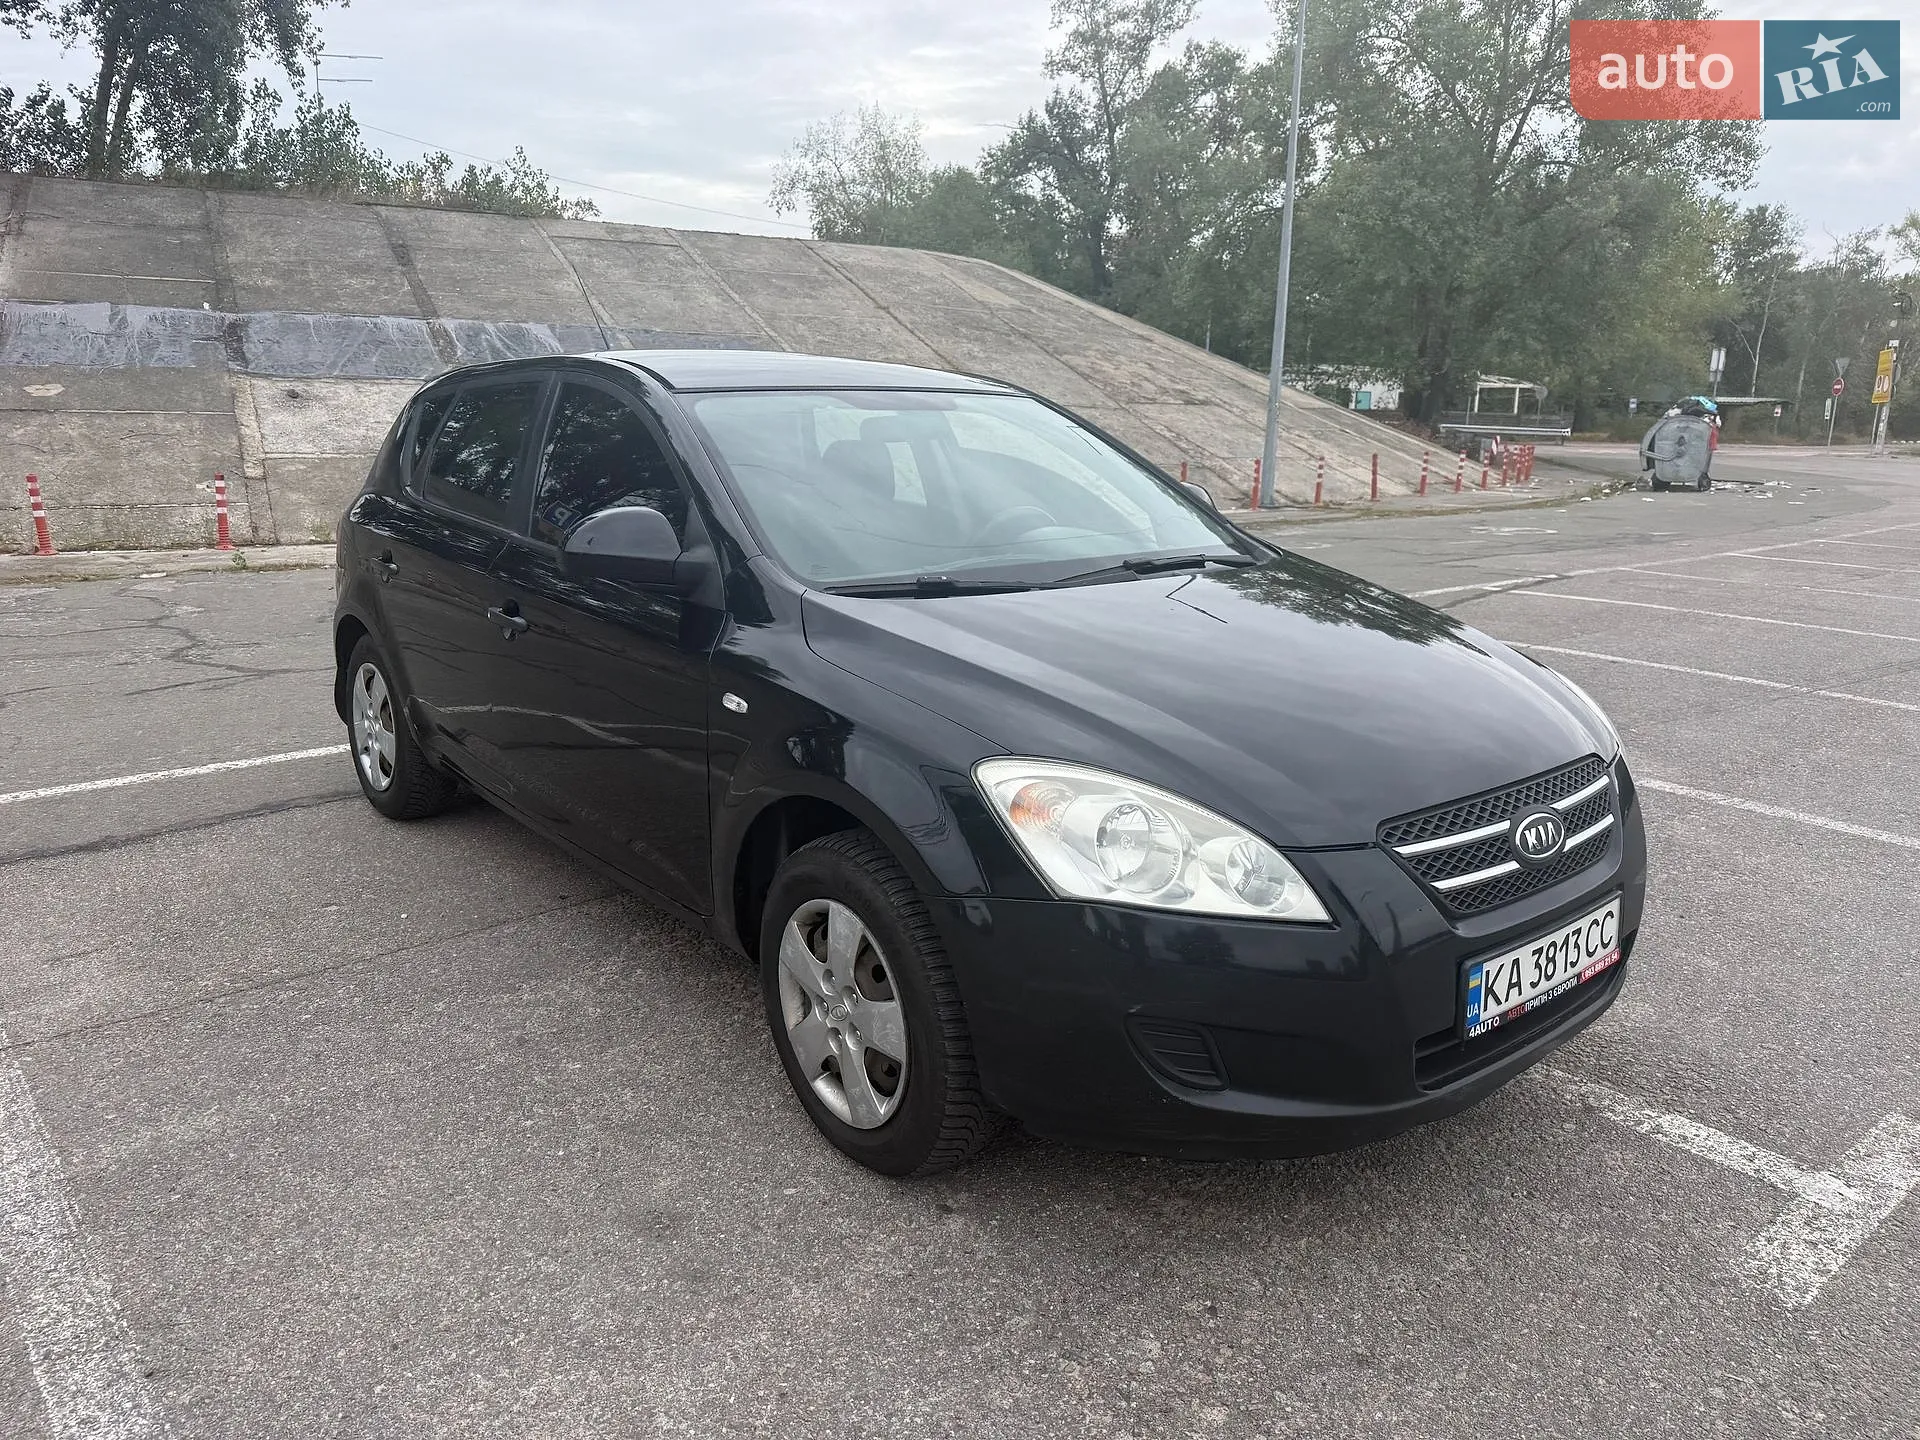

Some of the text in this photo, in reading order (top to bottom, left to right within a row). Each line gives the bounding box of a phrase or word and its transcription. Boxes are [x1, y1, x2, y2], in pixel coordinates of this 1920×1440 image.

[1523, 821, 1560, 852] KIA
[1482, 909, 1615, 1014] KA 3813 CC
[1467, 1002, 1479, 1018] UA
[1468, 1017, 1500, 1038] 4AUTO
